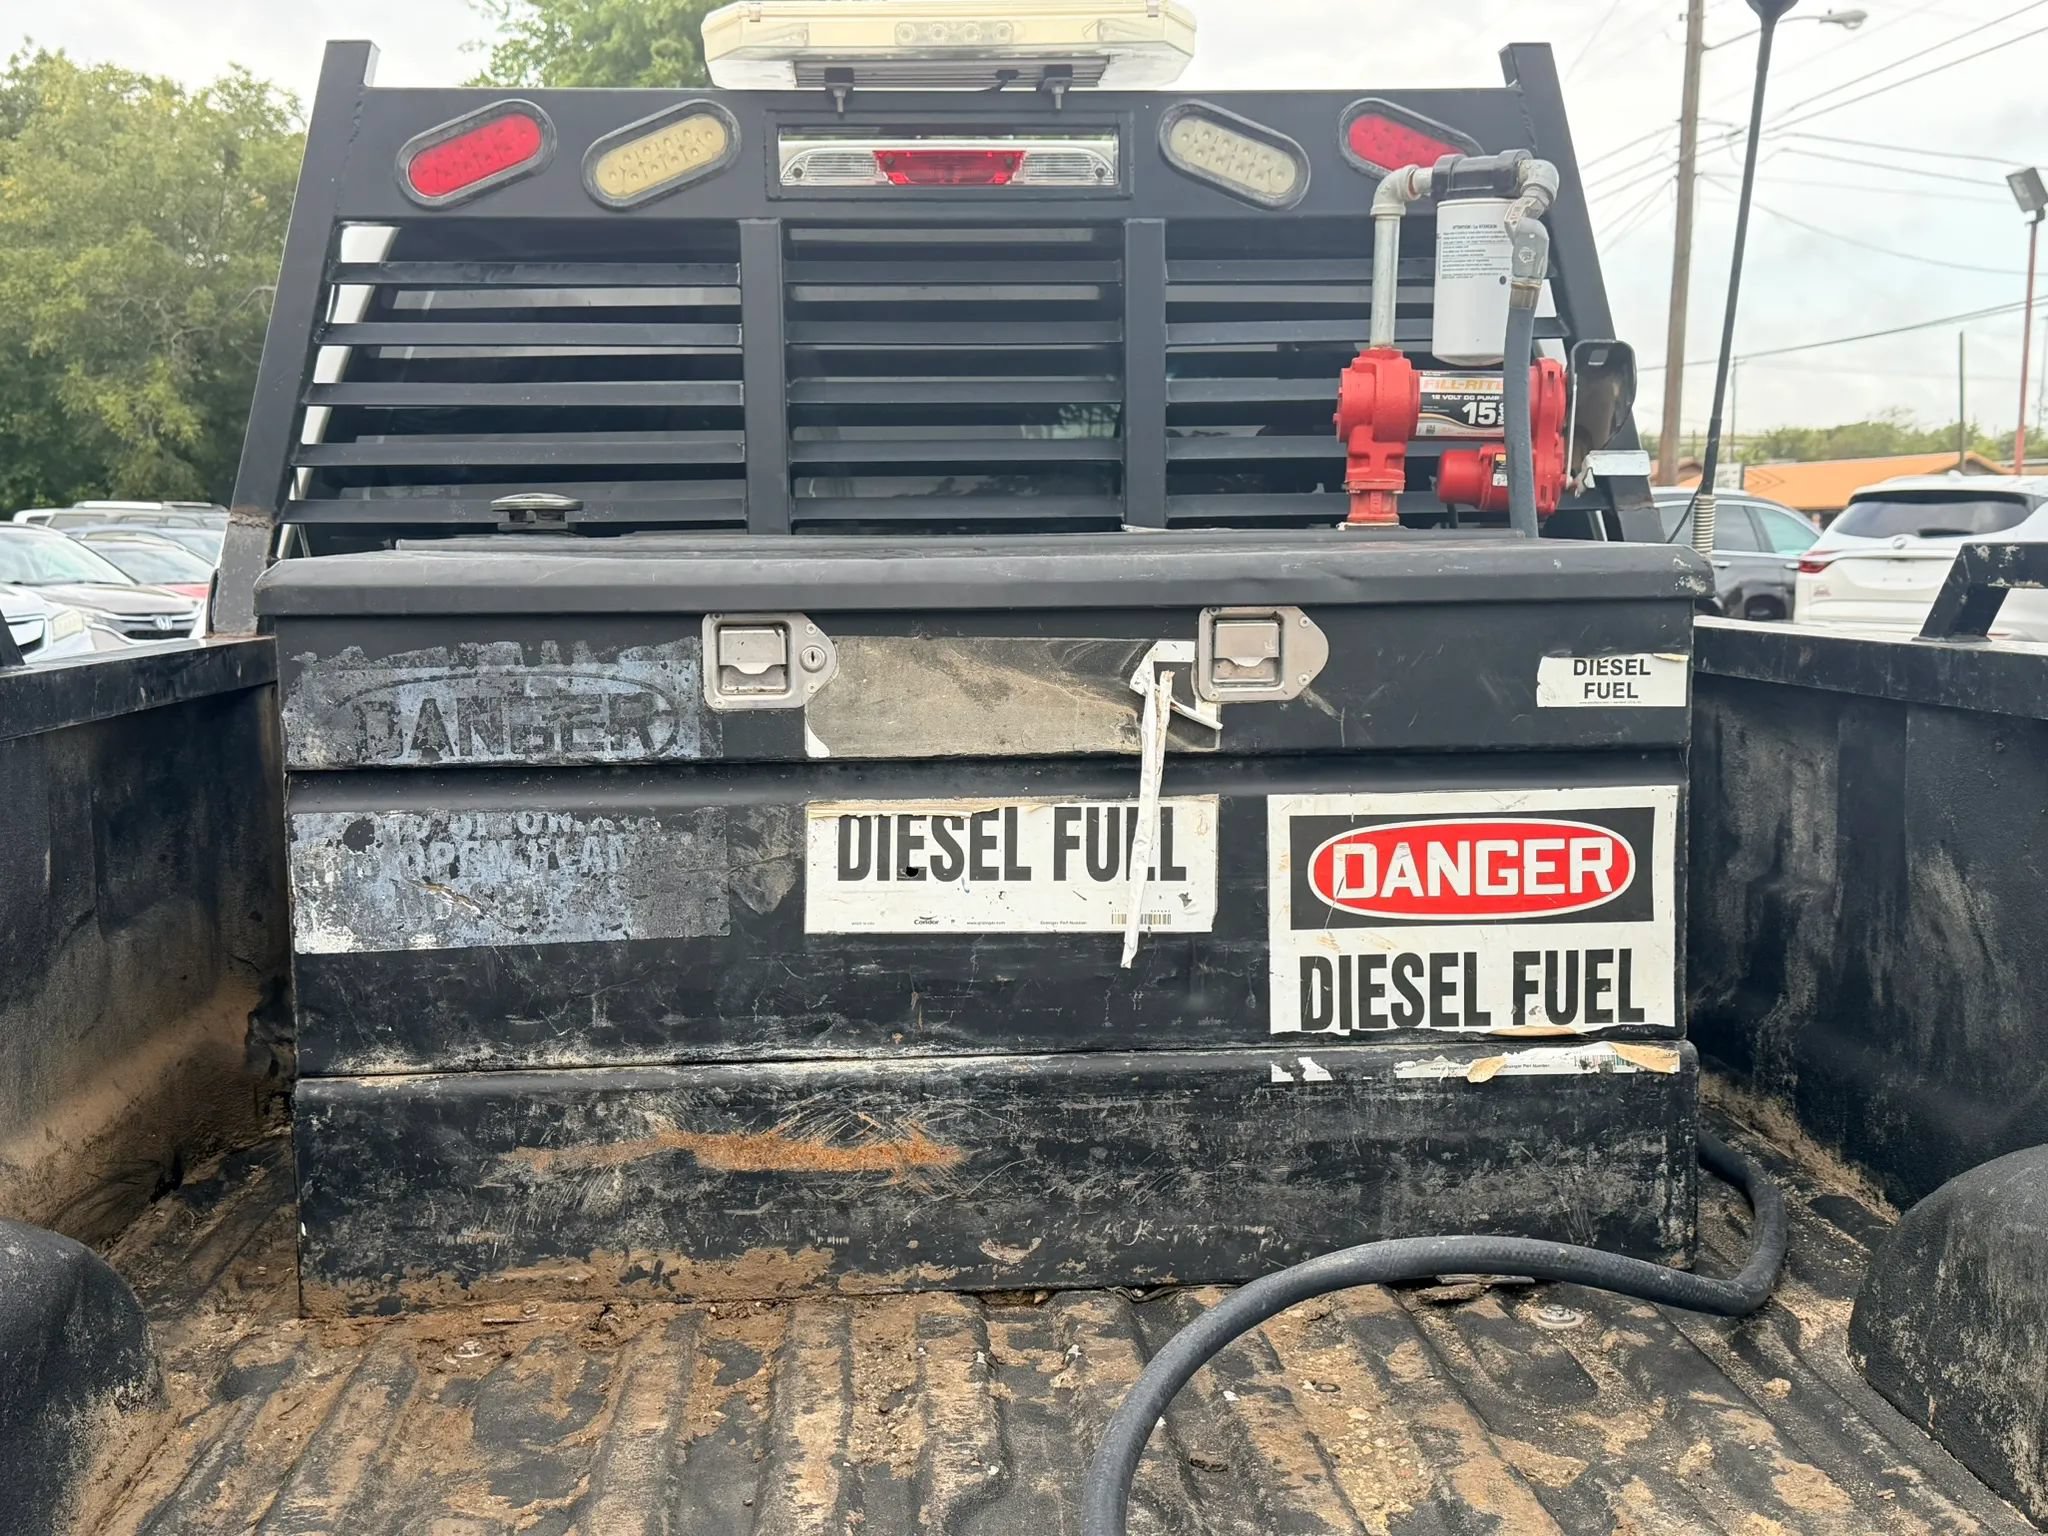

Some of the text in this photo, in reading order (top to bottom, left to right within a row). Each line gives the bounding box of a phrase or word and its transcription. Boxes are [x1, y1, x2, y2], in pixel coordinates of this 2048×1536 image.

[1573, 658, 1651, 676] DIESEL
[1584, 682, 1639, 699] FUEL
[837, 807, 1032, 882] DIESEL
[1332, 838, 1613, 898] DANGER
[1300, 948, 1645, 1031] DIESEL FUEL
